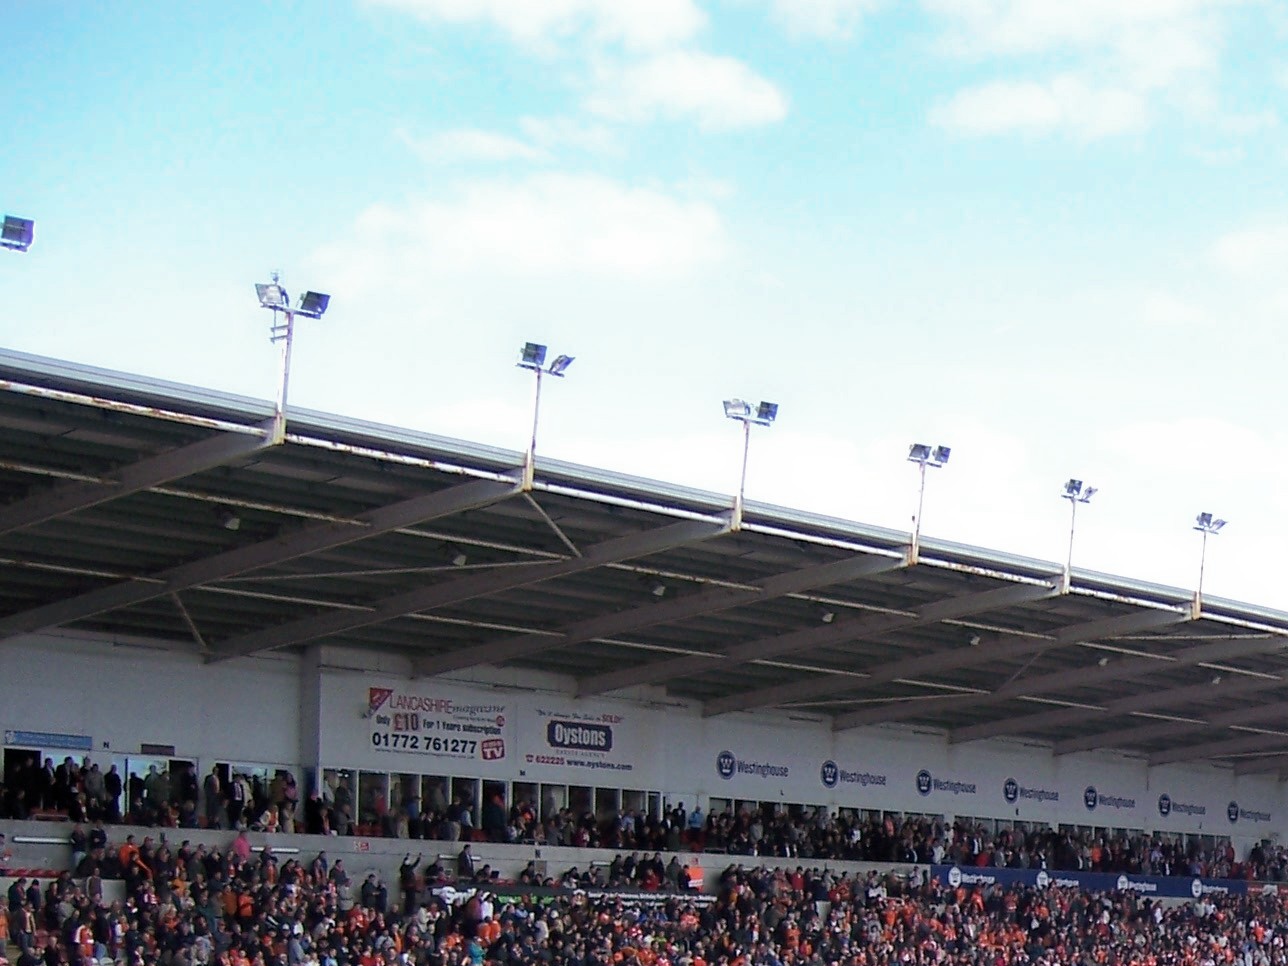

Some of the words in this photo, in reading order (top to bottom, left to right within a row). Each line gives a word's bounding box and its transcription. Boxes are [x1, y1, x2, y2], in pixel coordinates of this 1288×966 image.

[389, 694, 453, 714] LANCASHIRE
[376, 715, 390, 726] Only
[393, 712, 420, 731] £10
[423, 719, 436, 729] For
[442, 721, 461, 732] Years
[462, 723, 502, 735] subscription
[372, 732, 419, 749] 01772
[423, 736, 477, 754] 761277
[555, 723, 606, 747] Oystons
[482, 747, 504, 760] TV
[566, 759, 633, 770] www.oystons.com
[737, 760, 789, 779] Westinghouse
[839, 770, 887, 787] Westinghouse
[933, 778, 976, 795] Westinghouse
[1019, 787, 1059, 802] Westinghouse
[1098, 793, 1135, 809] Westinghouse
[1172, 801, 1205, 816] Westinghouse
[1240, 808, 1271, 822] Westinghouse
